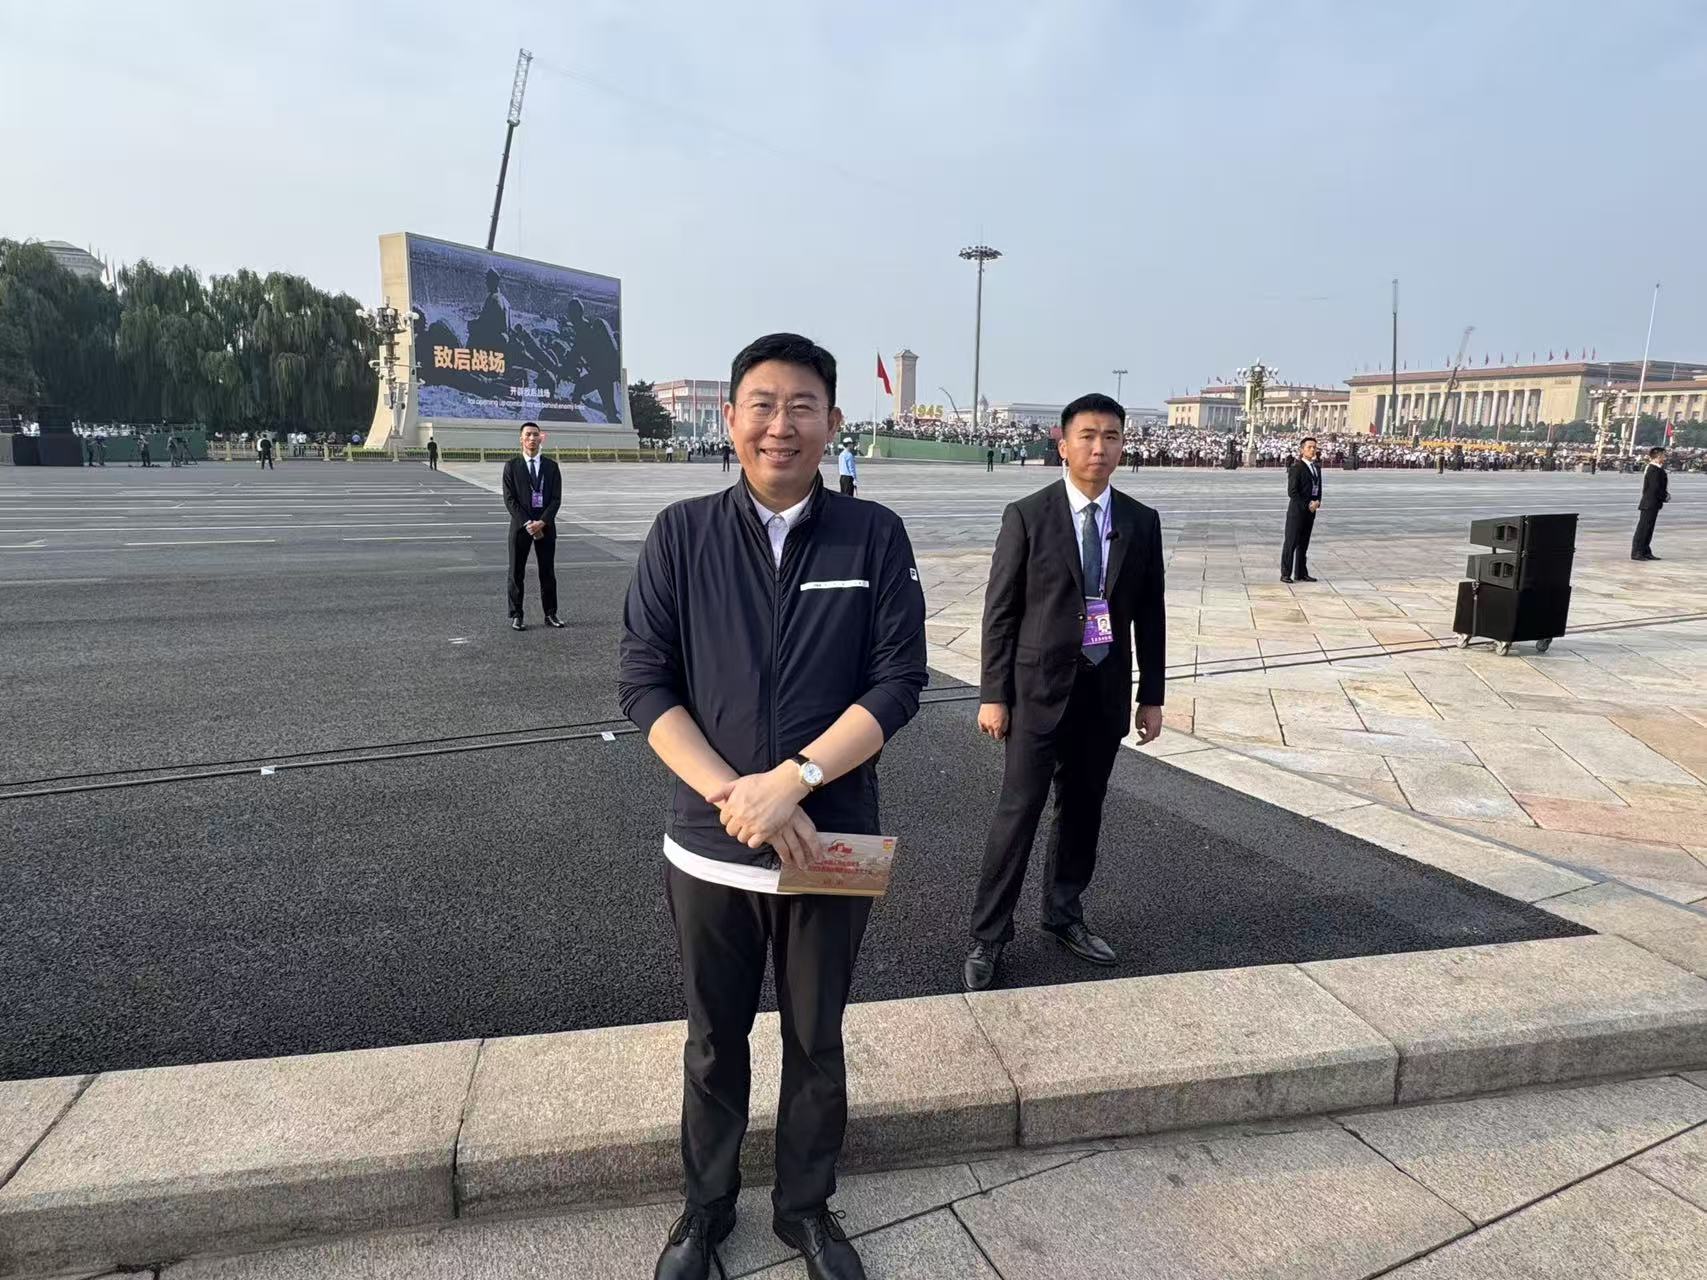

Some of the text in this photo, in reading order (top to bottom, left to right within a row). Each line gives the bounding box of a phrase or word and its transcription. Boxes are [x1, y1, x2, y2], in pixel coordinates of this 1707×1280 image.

[433, 345, 505, 373] 敌后战场
[912, 404, 944, 418] 1945
